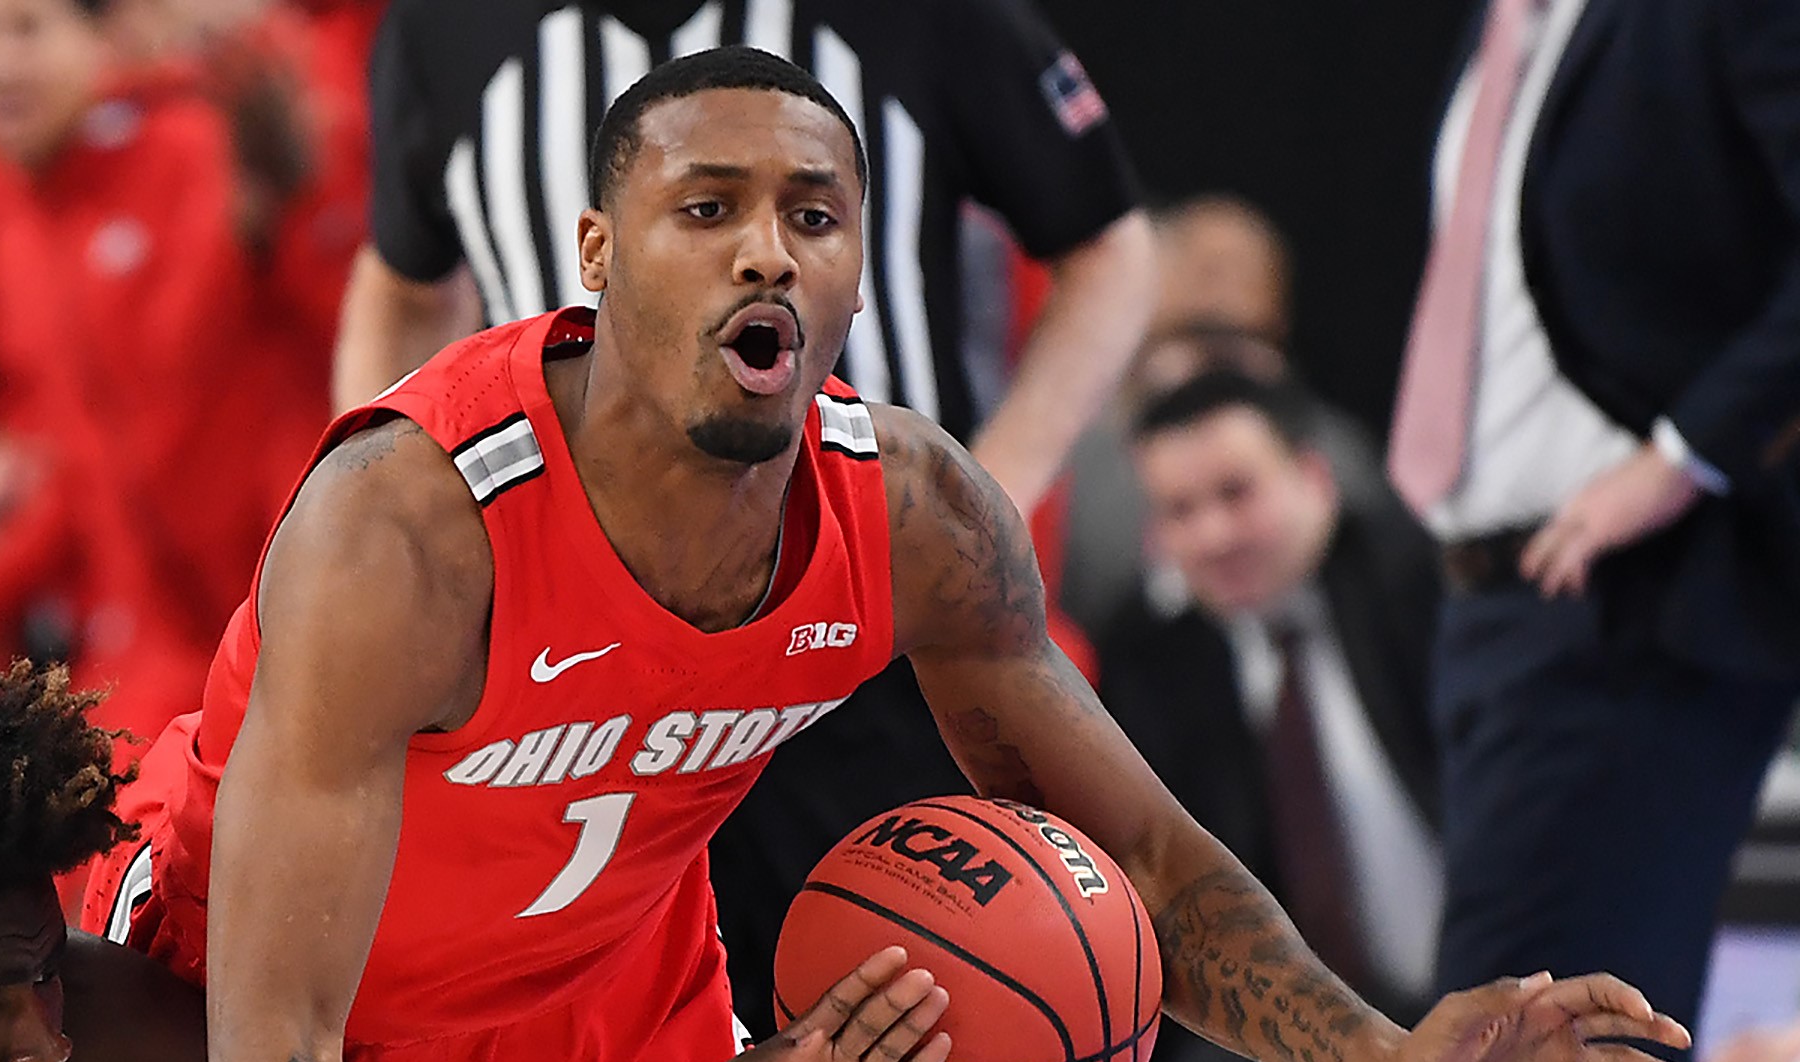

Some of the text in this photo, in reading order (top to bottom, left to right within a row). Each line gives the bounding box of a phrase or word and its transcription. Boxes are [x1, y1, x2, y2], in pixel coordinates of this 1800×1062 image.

[442, 713, 634, 788] OHIO
[514, 792, 637, 919] 1
[852, 815, 1013, 907] NCAA
